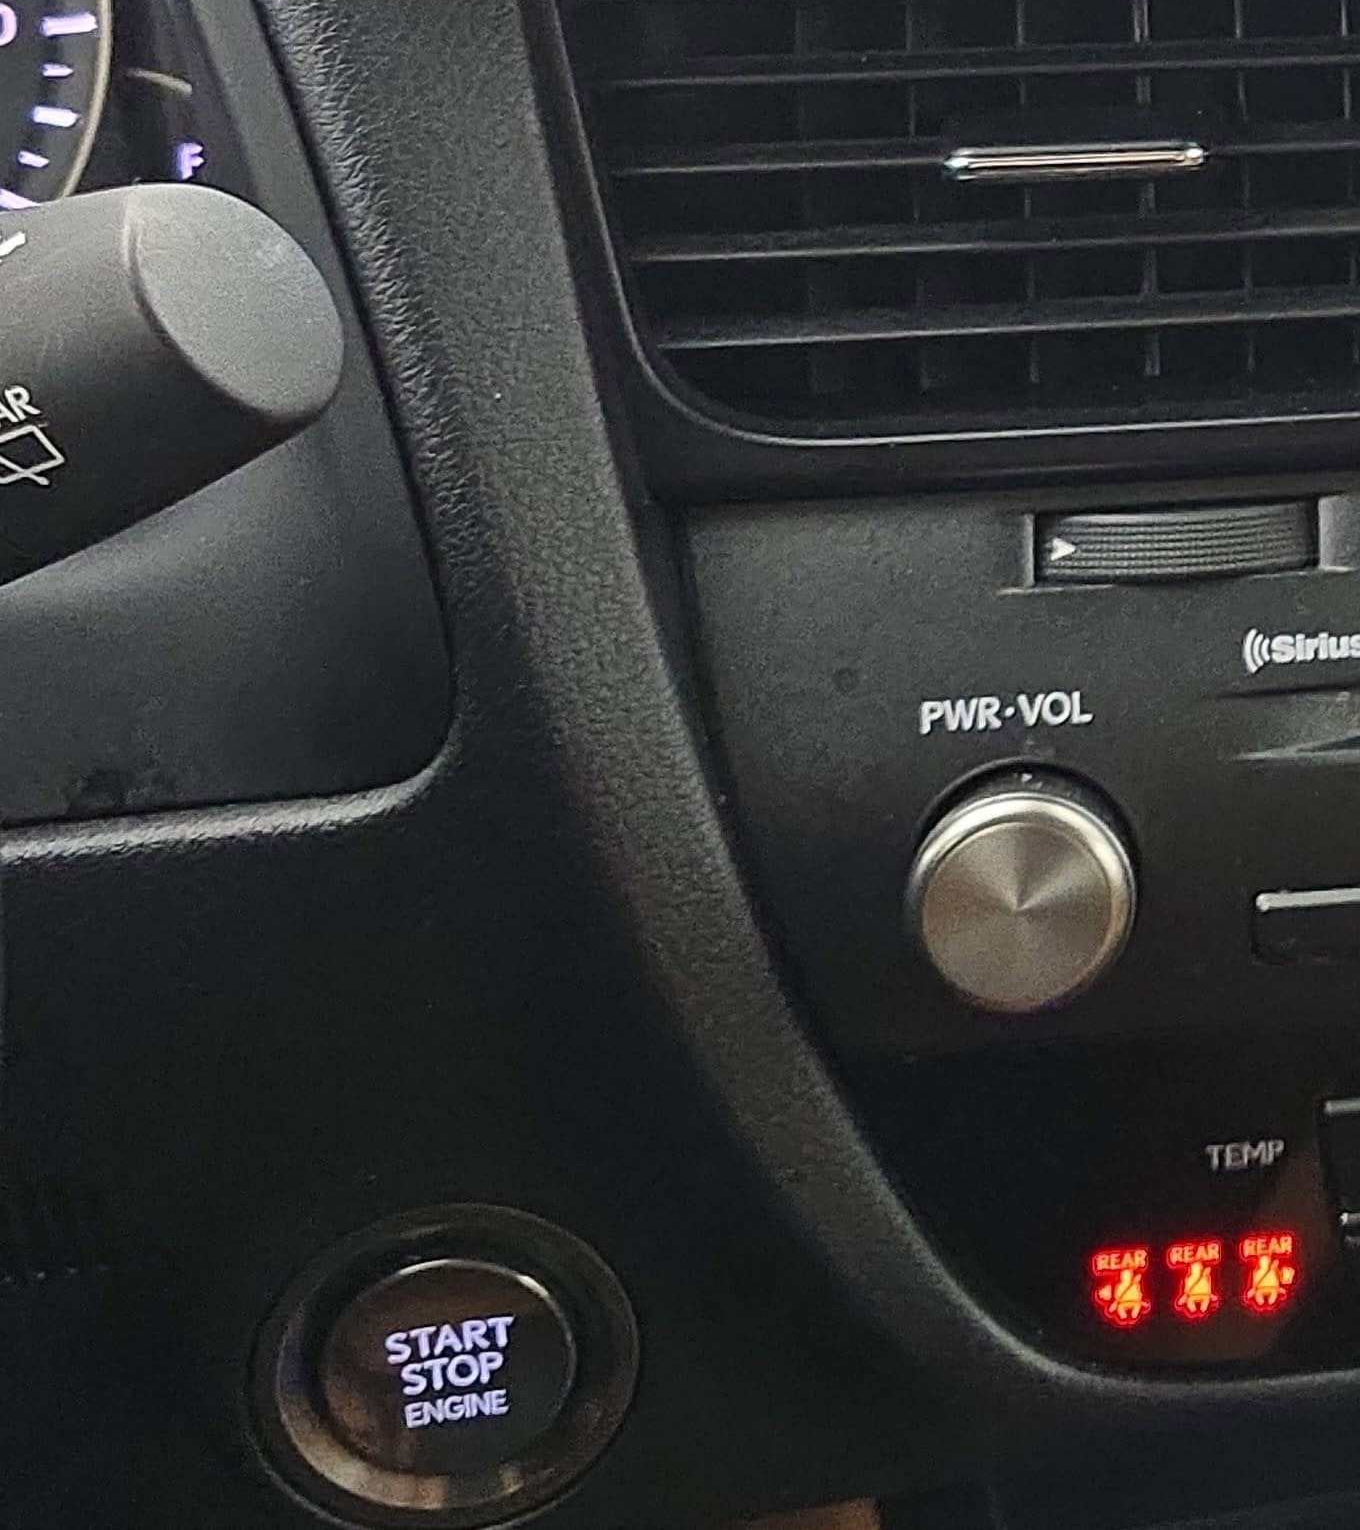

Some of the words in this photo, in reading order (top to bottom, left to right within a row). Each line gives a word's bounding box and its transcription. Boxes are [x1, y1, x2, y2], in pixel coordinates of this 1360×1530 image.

[177, 141, 205, 180] F
[1205, 1139, 1286, 1171] TEMP
[1095, 1248, 1149, 1271] REAR
[1170, 1241, 1221, 1265] REAR
[1242, 1234, 1293, 1258] REAR
[384, 1315, 515, 1366] START
[400, 1351, 504, 1396] STOP
[404, 1388, 511, 1429] ENGINE
